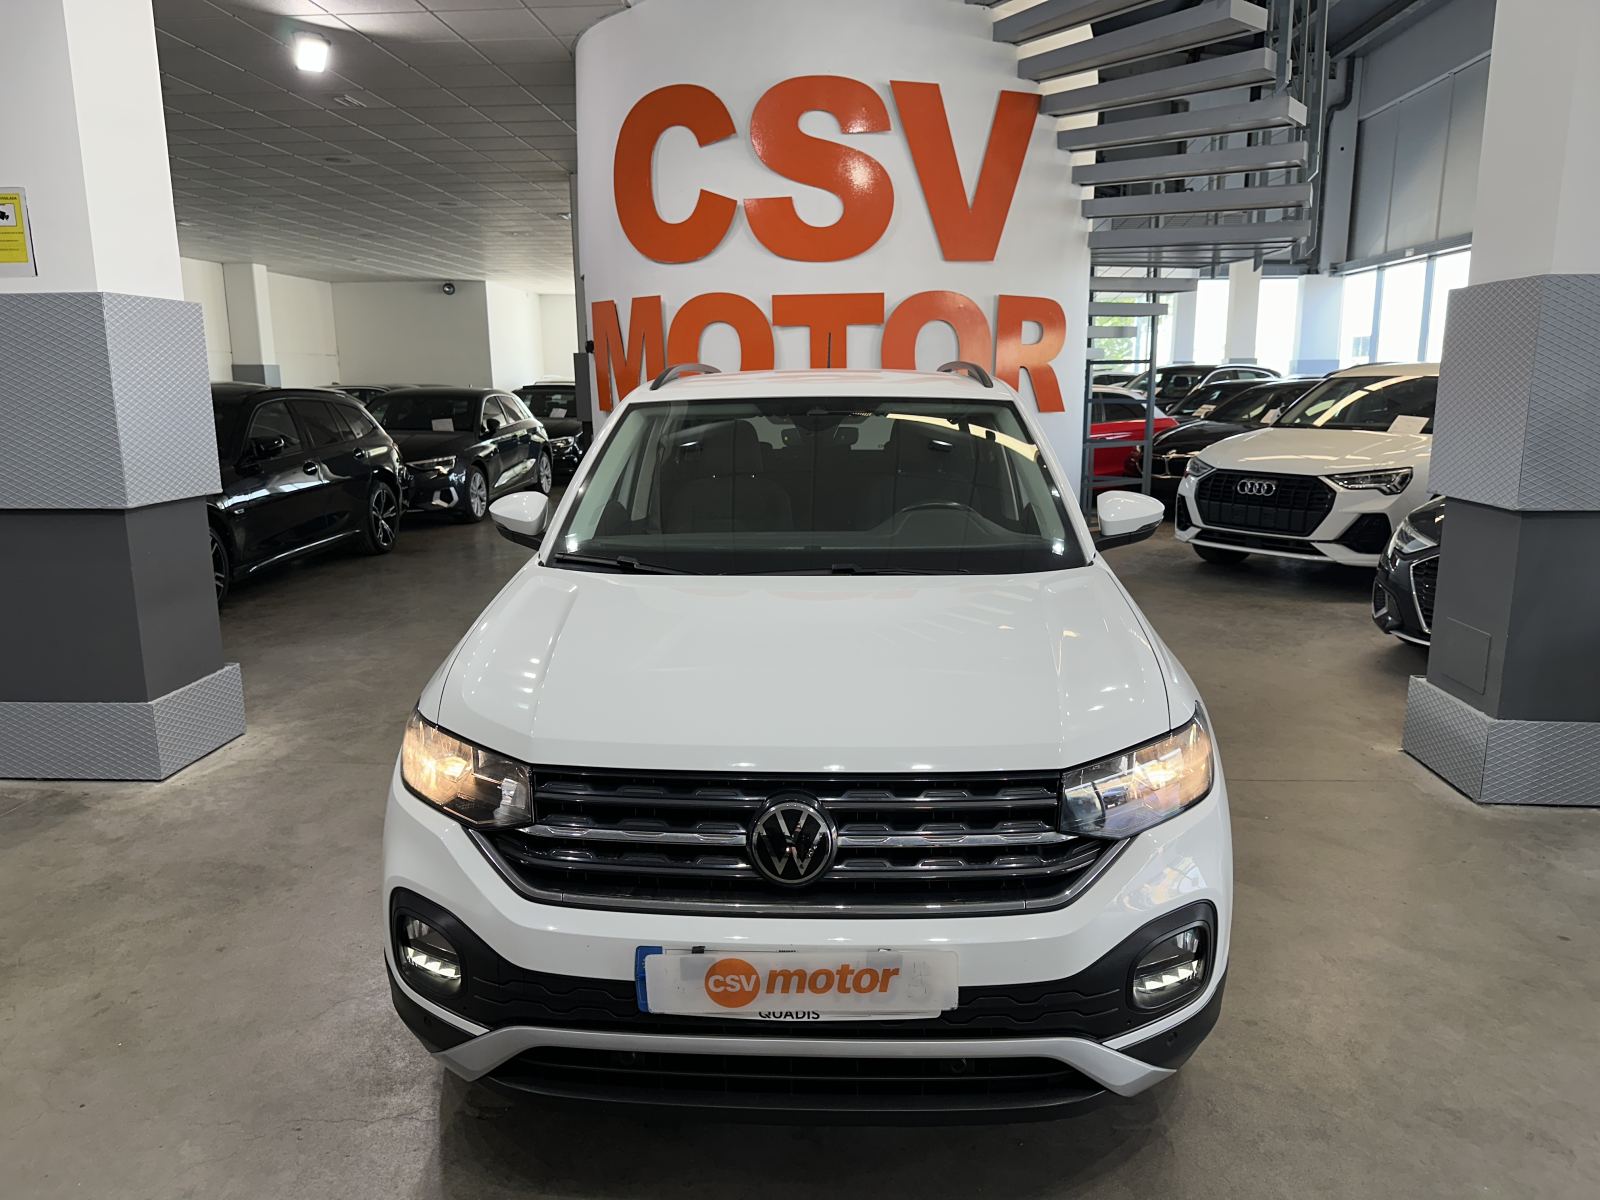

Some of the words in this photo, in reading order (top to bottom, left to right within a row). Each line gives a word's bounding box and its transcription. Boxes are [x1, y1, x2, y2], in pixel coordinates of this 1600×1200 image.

[613, 75, 1043, 264] CSV
[591, 290, 1066, 413] MOTOR
[758, 1010, 820, 1020] QUADIS
[765, 964, 900, 995] motor
